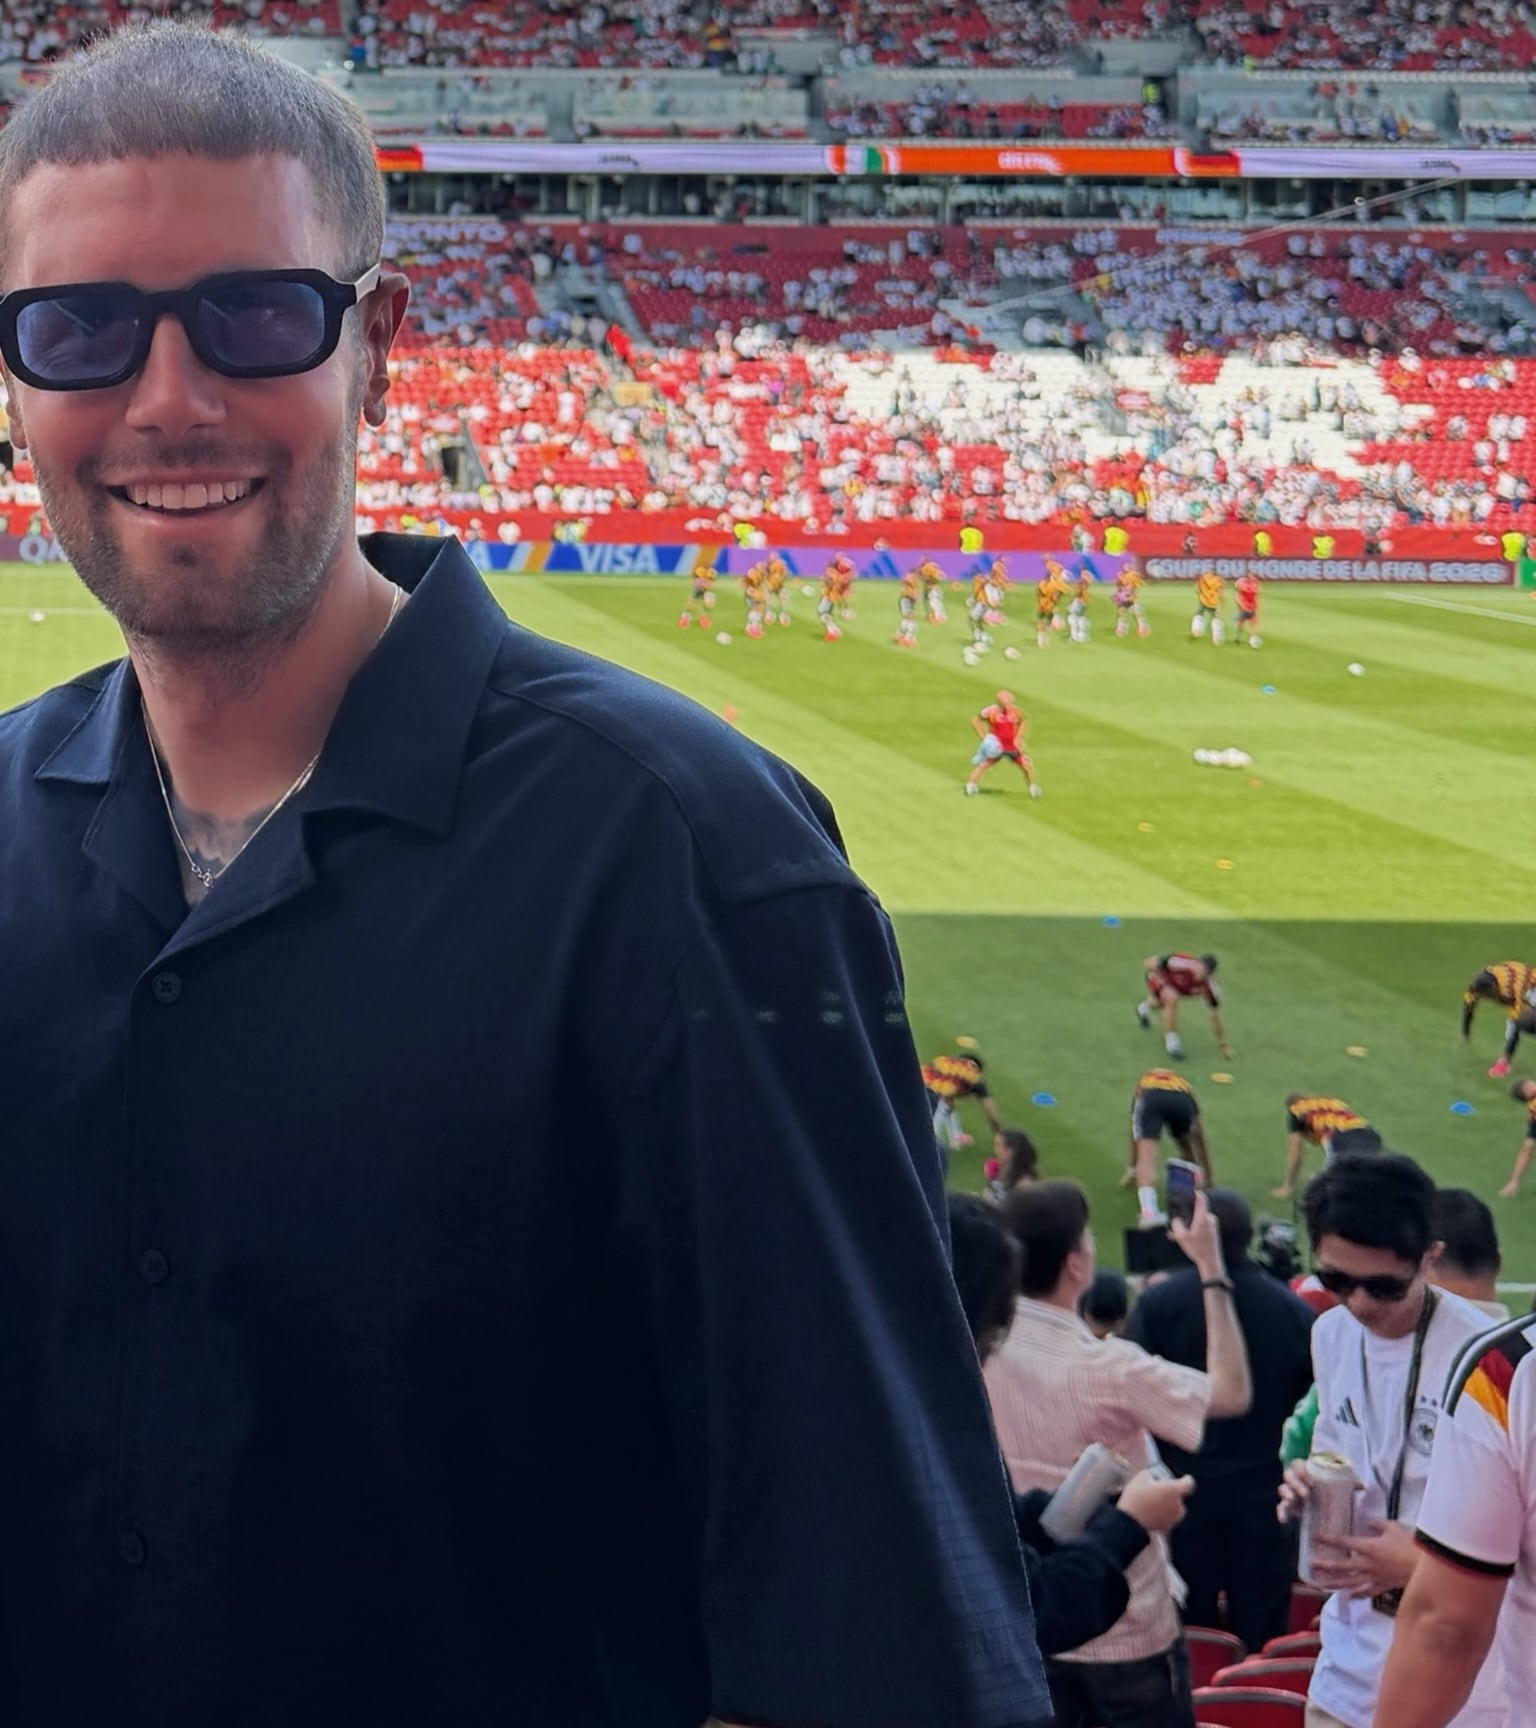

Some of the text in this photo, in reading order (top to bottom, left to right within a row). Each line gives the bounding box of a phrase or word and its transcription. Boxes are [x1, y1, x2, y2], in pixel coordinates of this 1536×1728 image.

[576, 543, 660, 574] VISA
[1216, 559, 1246, 578] DU
[1322, 560, 1352, 581] DE
[1352, 560, 1381, 581] LA
[1381, 561, 1428, 582] FIFA
[1428, 562, 1507, 583] 2026
